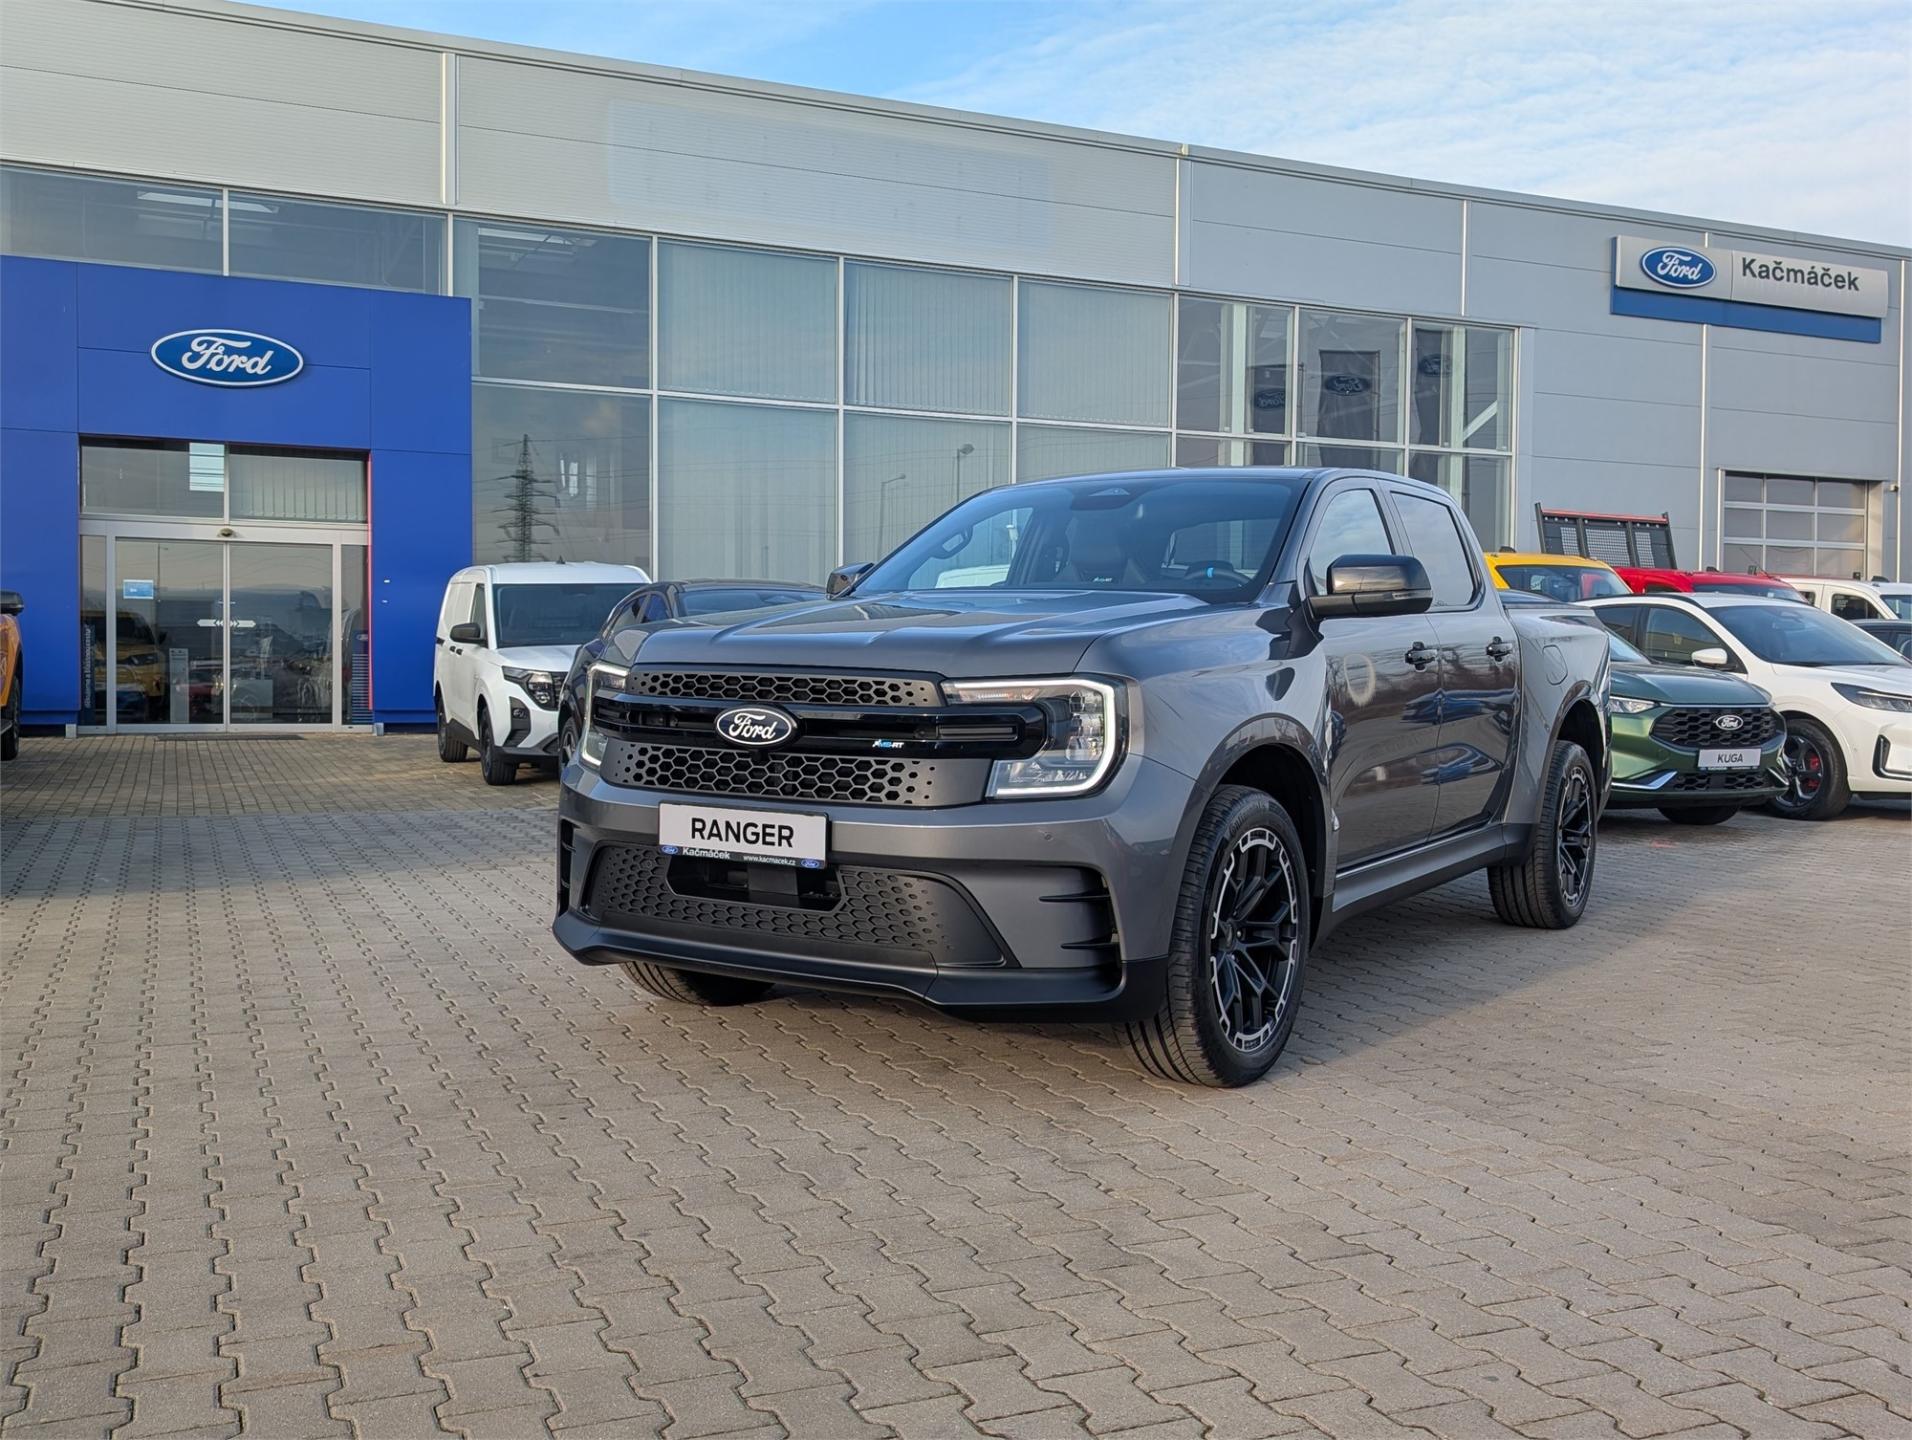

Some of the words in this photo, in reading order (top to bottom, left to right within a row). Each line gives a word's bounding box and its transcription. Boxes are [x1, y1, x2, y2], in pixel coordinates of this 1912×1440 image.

[1657, 252, 1701, 280] Ford
[1742, 257, 1859, 291] Kačmáček
[181, 336, 274, 375] Ford
[728, 713, 776, 739] Ford
[1717, 753, 1744, 764] KUGA
[691, 818, 794, 848] RANGER
[682, 846, 731, 860] Kačmáček
[743, 854, 796, 866] www.kacmacek.cz
